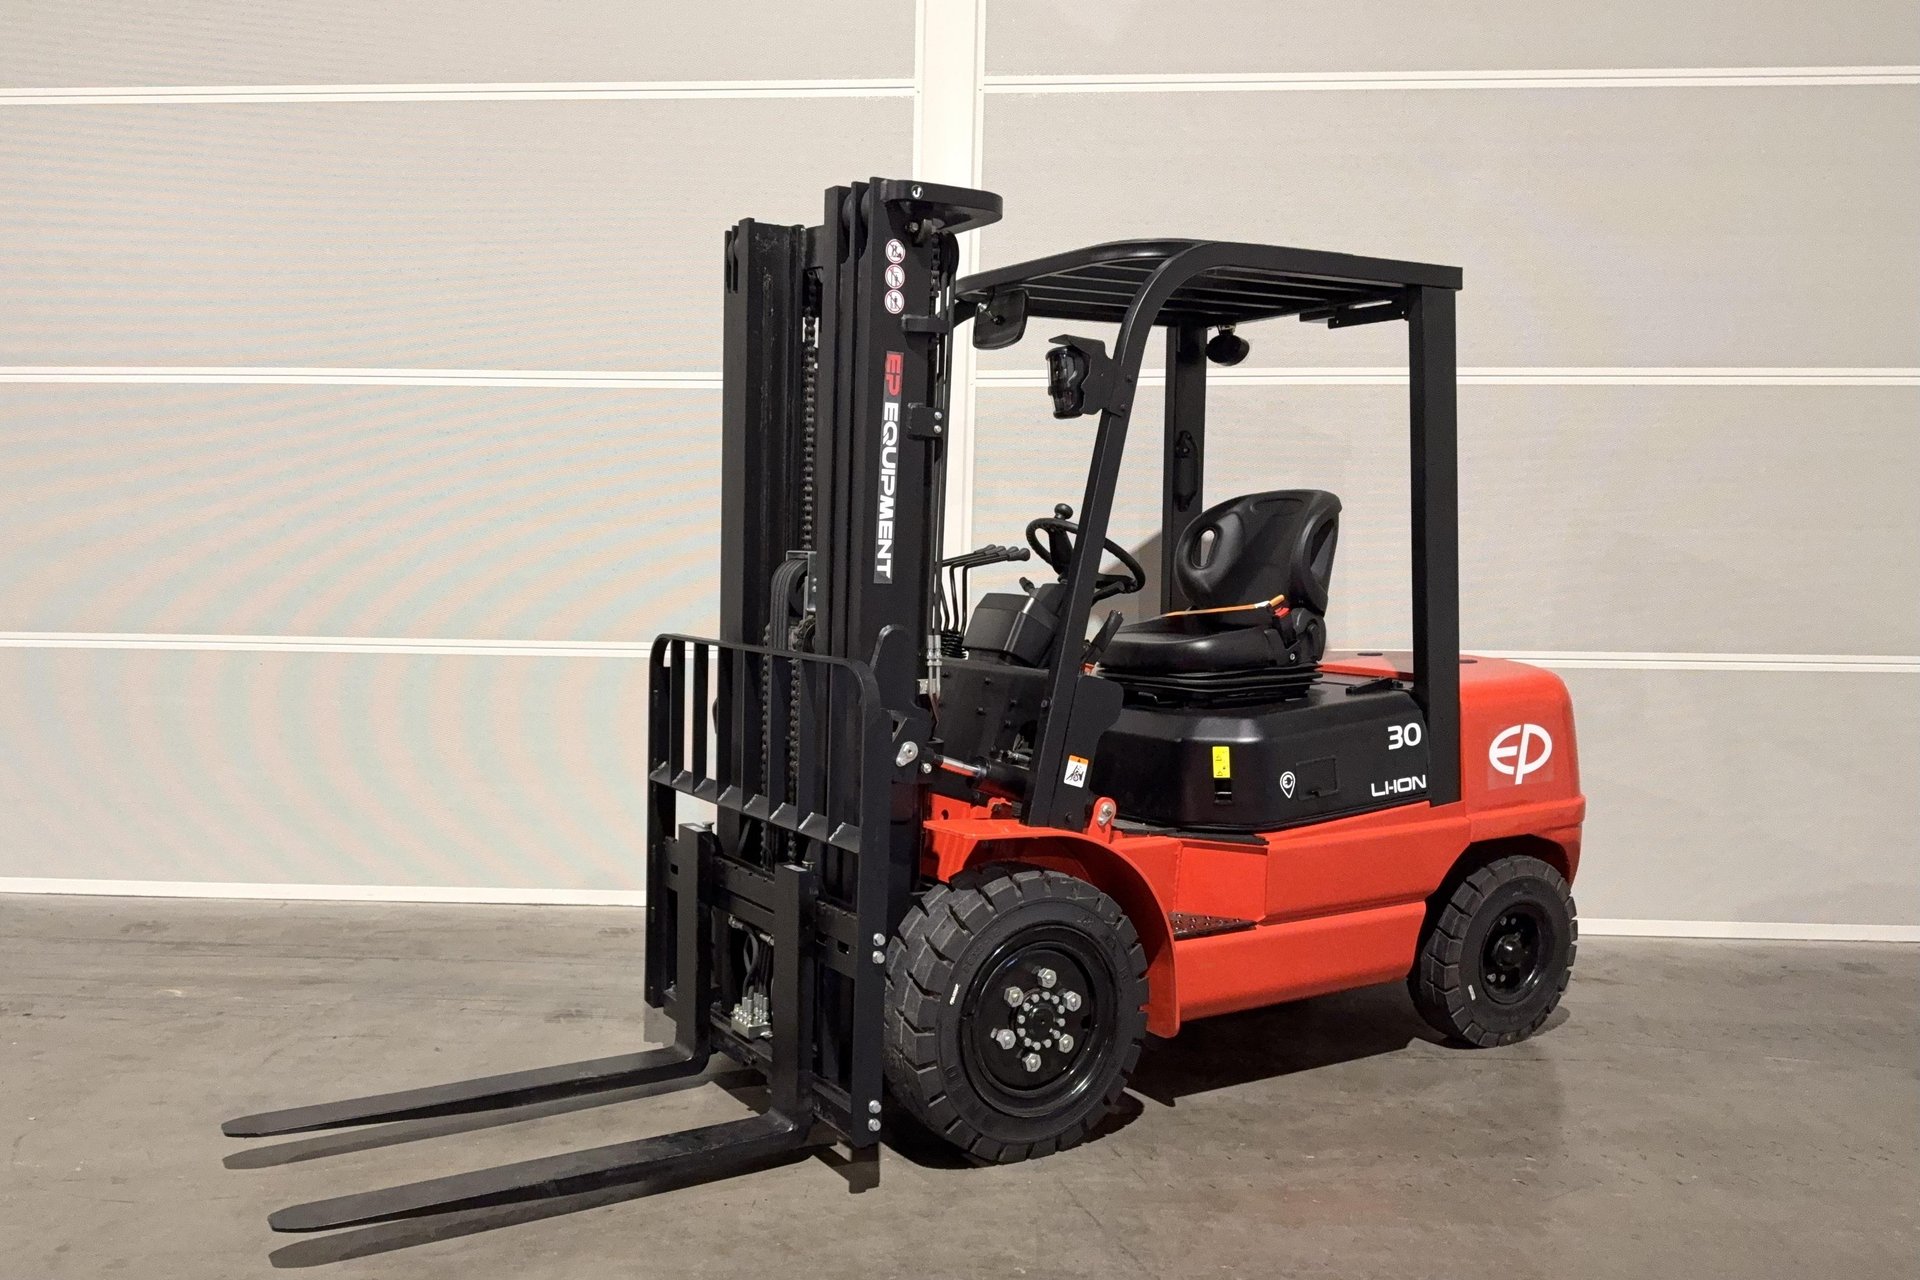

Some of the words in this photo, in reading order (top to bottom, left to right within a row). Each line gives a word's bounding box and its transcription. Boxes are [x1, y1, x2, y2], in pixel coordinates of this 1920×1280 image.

[885, 353, 902, 396] EP
[876, 401, 900, 579] EQUIPMENT
[1387, 722, 1422, 750] 30
[1488, 723, 1553, 785] EP
[1370, 774, 1427, 798] LI-ION
